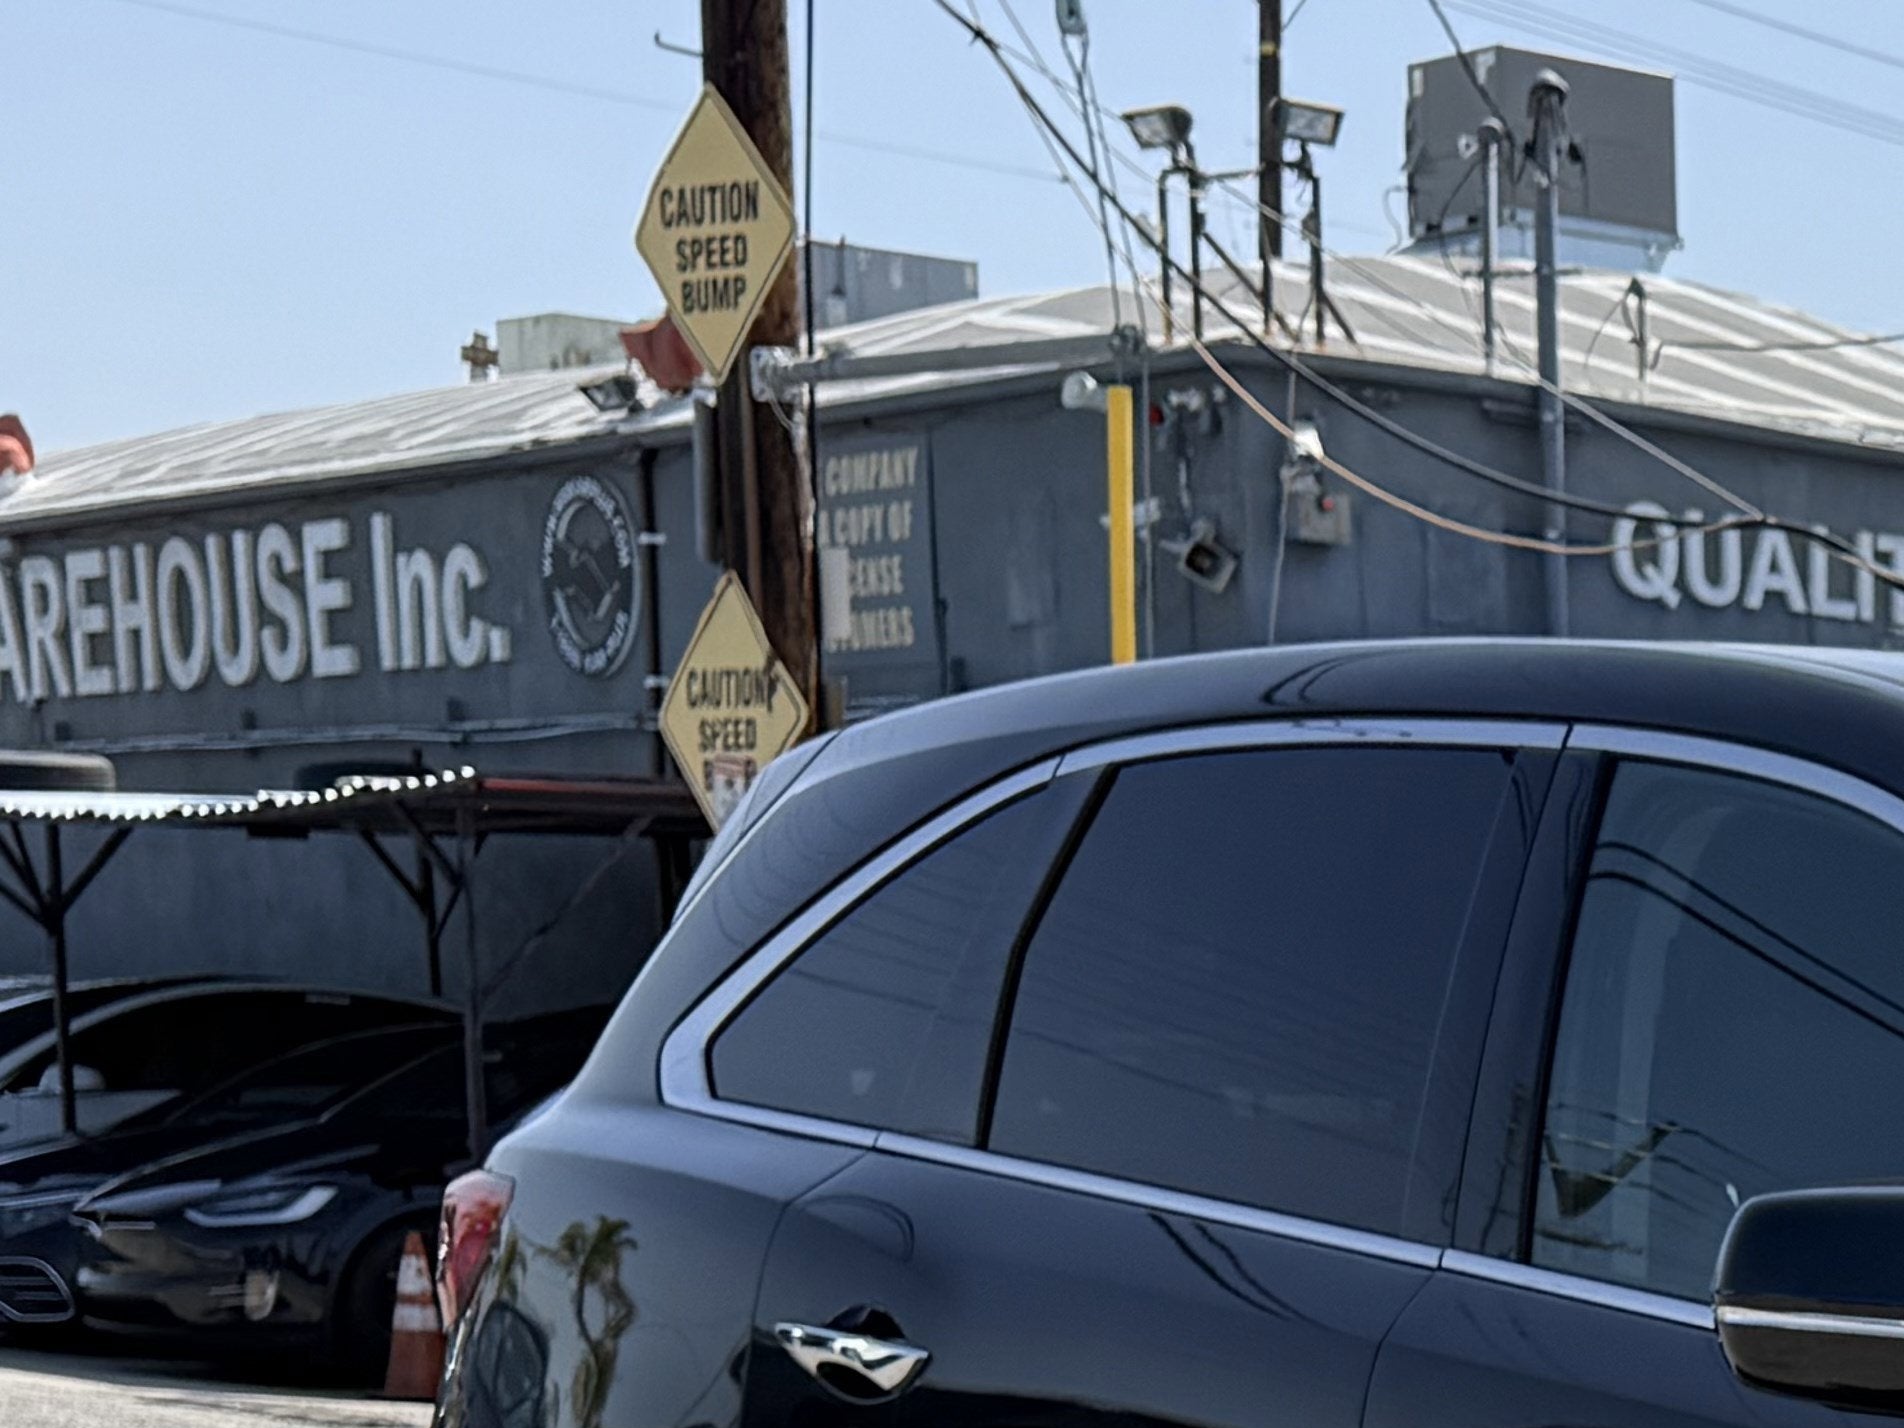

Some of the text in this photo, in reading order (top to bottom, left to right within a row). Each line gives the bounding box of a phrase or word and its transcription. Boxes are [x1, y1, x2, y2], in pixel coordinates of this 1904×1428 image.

[660, 180, 759, 230] CAUTION
[676, 234, 748, 273] SPEED
[681, 275, 747, 315] BUMP
[825, 447, 918, 497] COMPANY
[834, 504, 886, 546] COPY
[887, 501, 912, 542] OF
[369, 511, 512, 672] Inc.
[686, 667, 768, 709] CAUTION
[699, 717, 757, 752] SPEED
